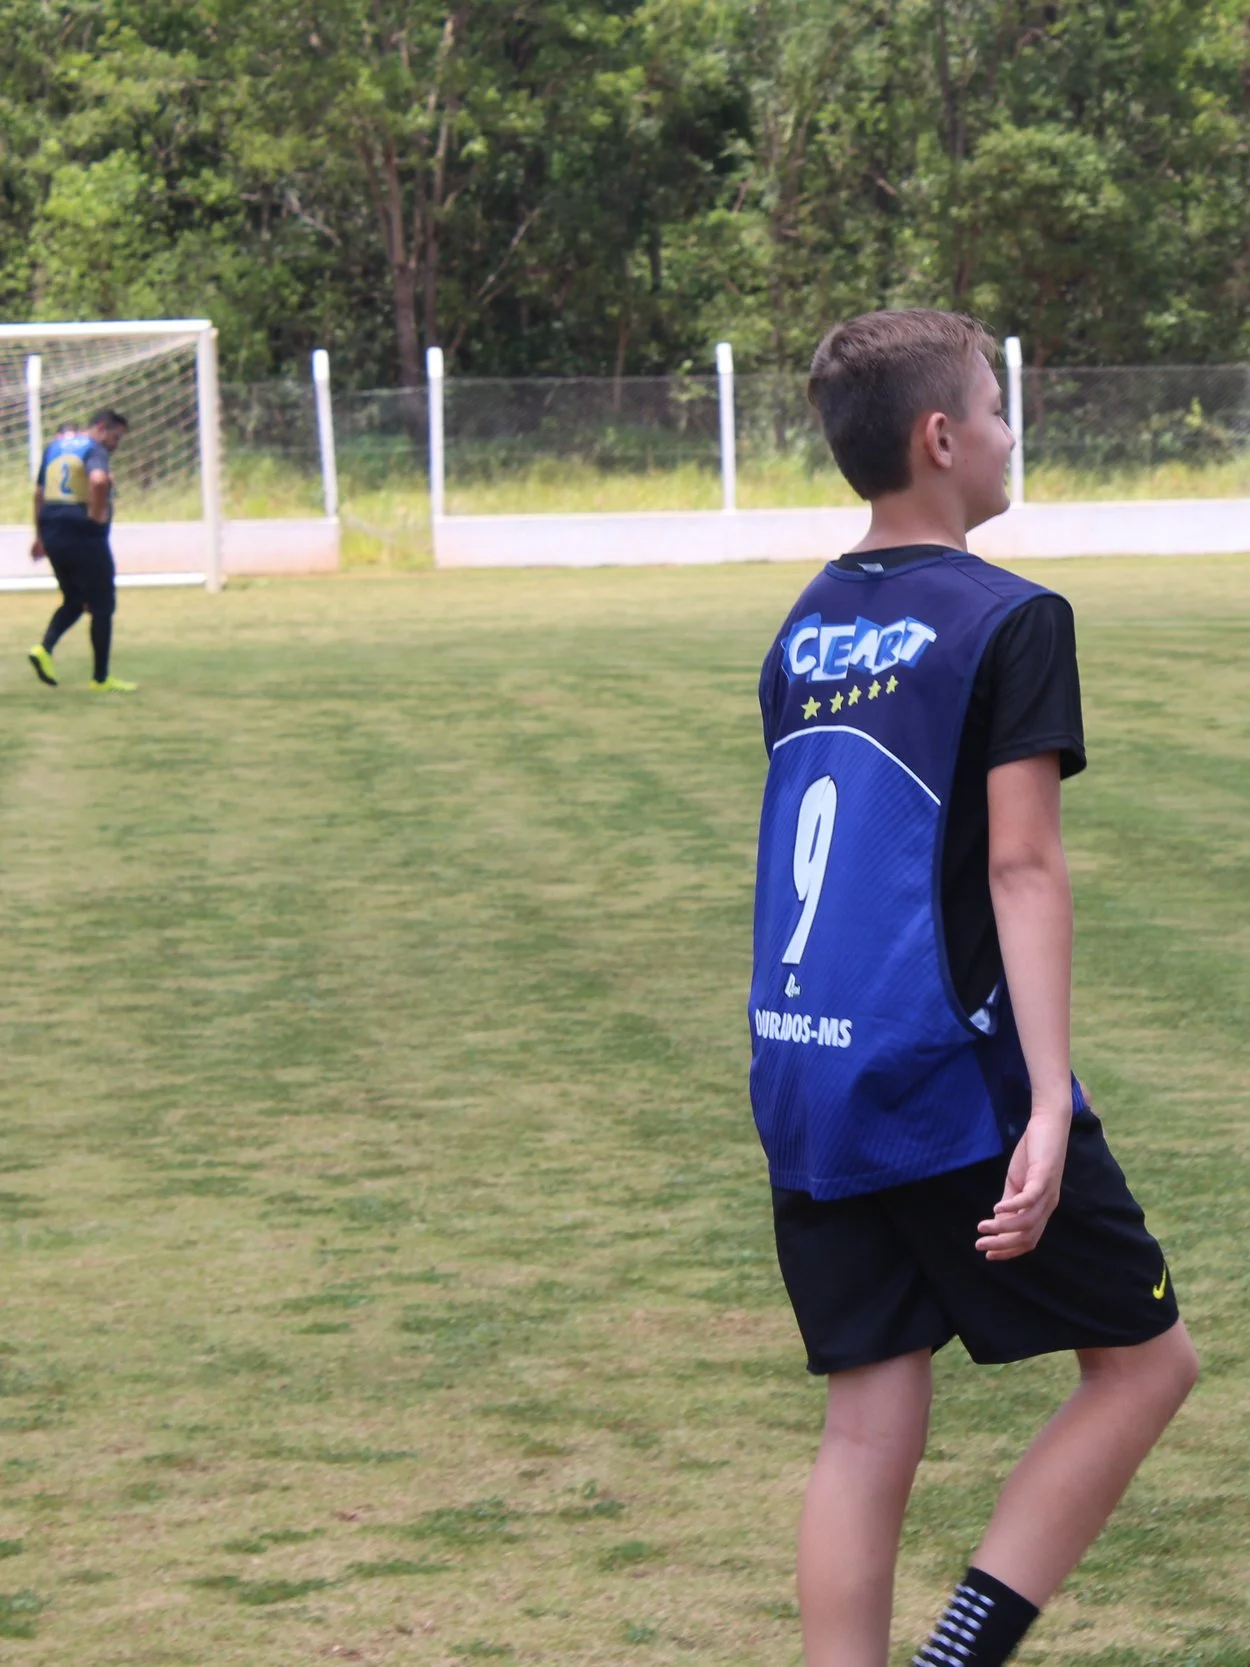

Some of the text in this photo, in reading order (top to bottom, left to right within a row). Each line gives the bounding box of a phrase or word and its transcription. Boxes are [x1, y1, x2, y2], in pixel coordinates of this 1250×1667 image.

[60, 463, 73, 494] 2
[786, 617, 937, 682] CEART
[781, 775, 837, 964] 9
